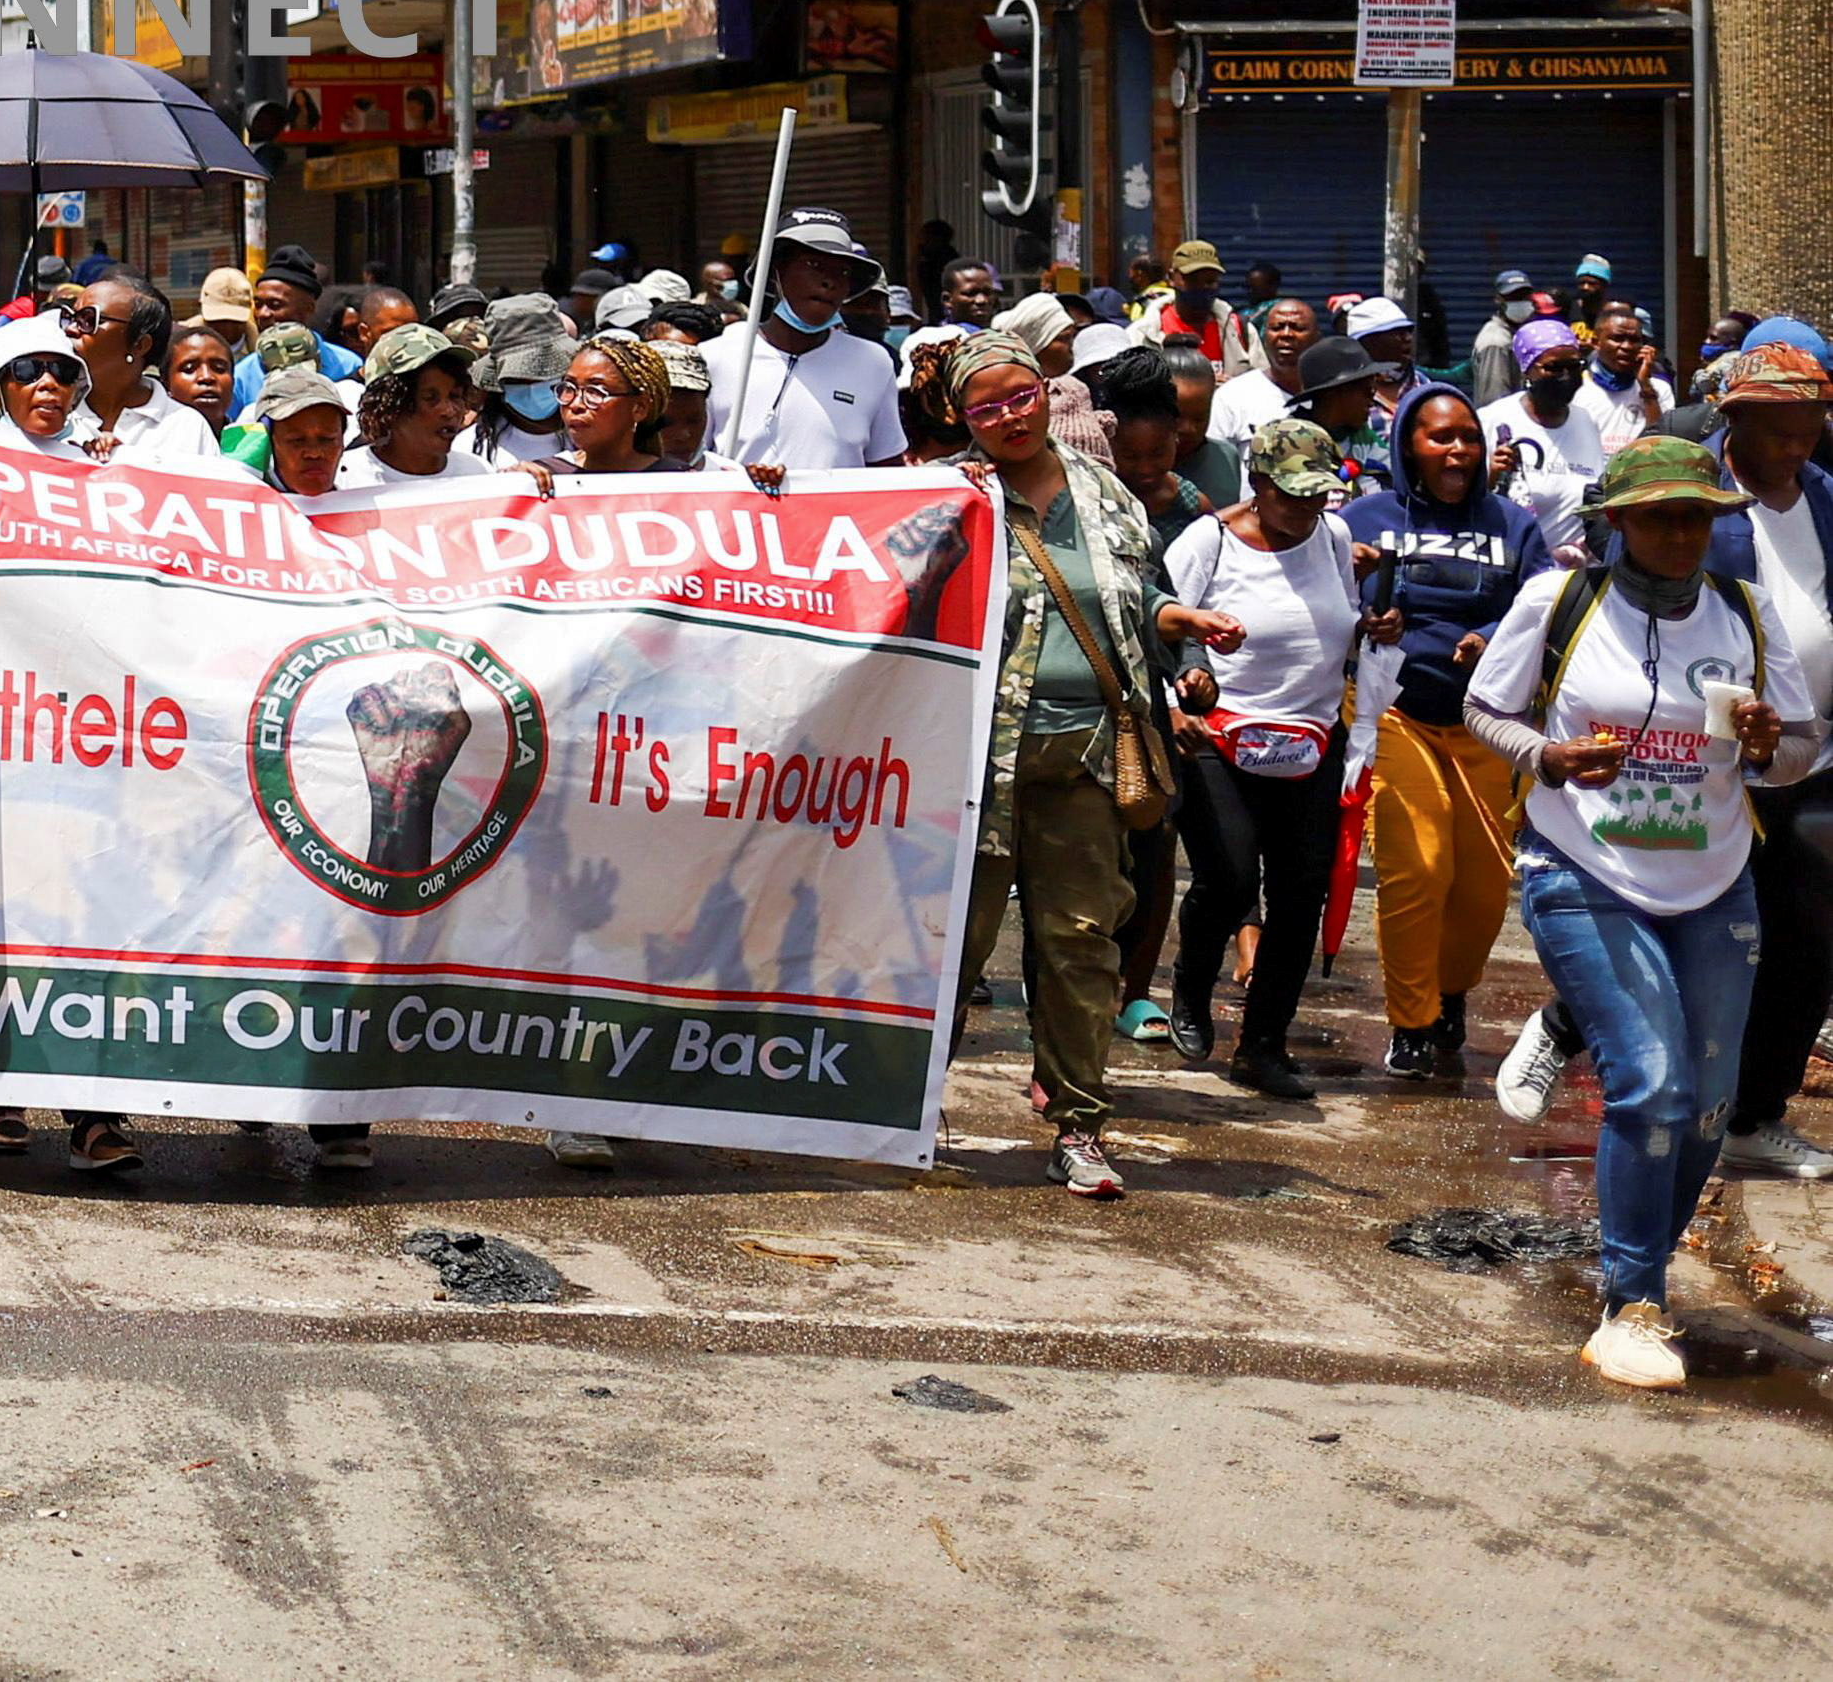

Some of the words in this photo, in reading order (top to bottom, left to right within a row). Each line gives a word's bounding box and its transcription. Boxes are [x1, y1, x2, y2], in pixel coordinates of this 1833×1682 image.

[1367, 31, 1423, 40] MANAGEMENT
[1368, 9, 1421, 18] ENGINEERING
[1213, 60, 1281, 80] CLAIM
[1507, 58, 1522, 77] &
[1529, 56, 1668, 77] CHISANYAMA
[70, 536, 194, 575] AFRICA
[202, 558, 270, 589] FOR
[406, 576, 527, 606] SOUTH
[533, 577, 705, 601] AFRICANS
[712, 578, 836, 617] FIRST!!!
[471, 508, 890, 584] DUDULA
[1378, 529, 1507, 566] UZZI
[258, 625, 416, 753] OPERATION
[434, 636, 536, 771] DUDULA
[588, 711, 671, 813] It's
[703, 725, 911, 850] Enough
[273, 799, 305, 840] OUR
[300, 839, 390, 901] ECONOMY
[417, 872, 447, 899] OUR
[449, 810, 509, 880] HERITAGE
[221, 987, 371, 1055] Our
[385, 993, 652, 1080] Country
[669, 1018, 850, 1087] Back
